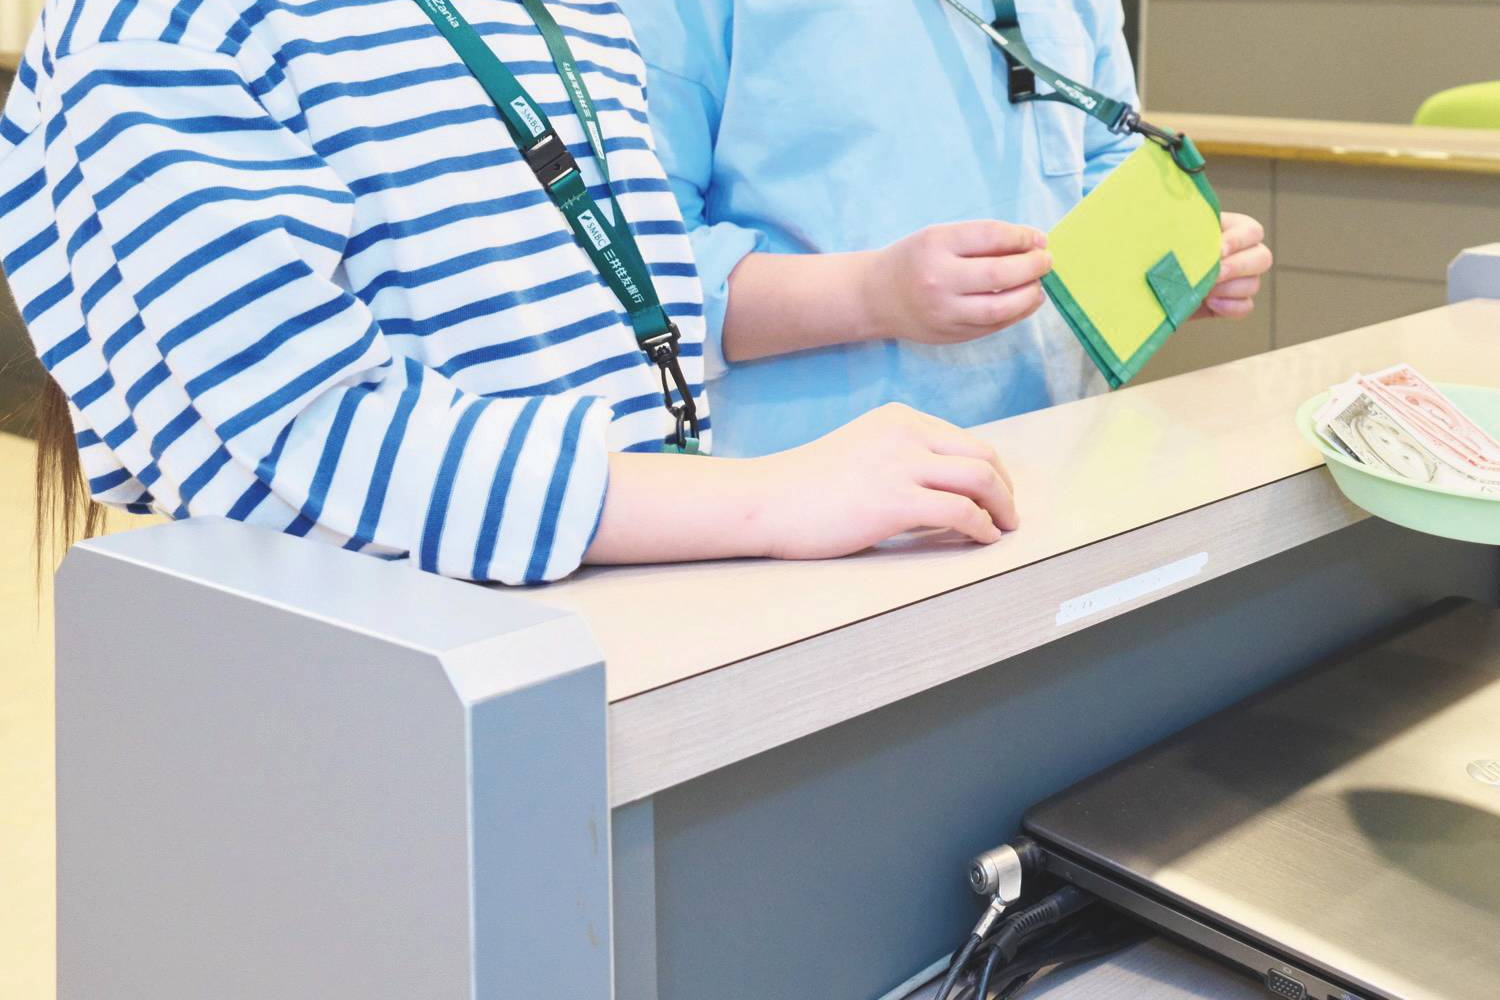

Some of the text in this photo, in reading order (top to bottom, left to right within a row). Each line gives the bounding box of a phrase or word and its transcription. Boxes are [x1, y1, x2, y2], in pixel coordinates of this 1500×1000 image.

[521, 108, 542, 133] SMBC
[587, 222, 644, 303] SMBC 三井住友銀行
